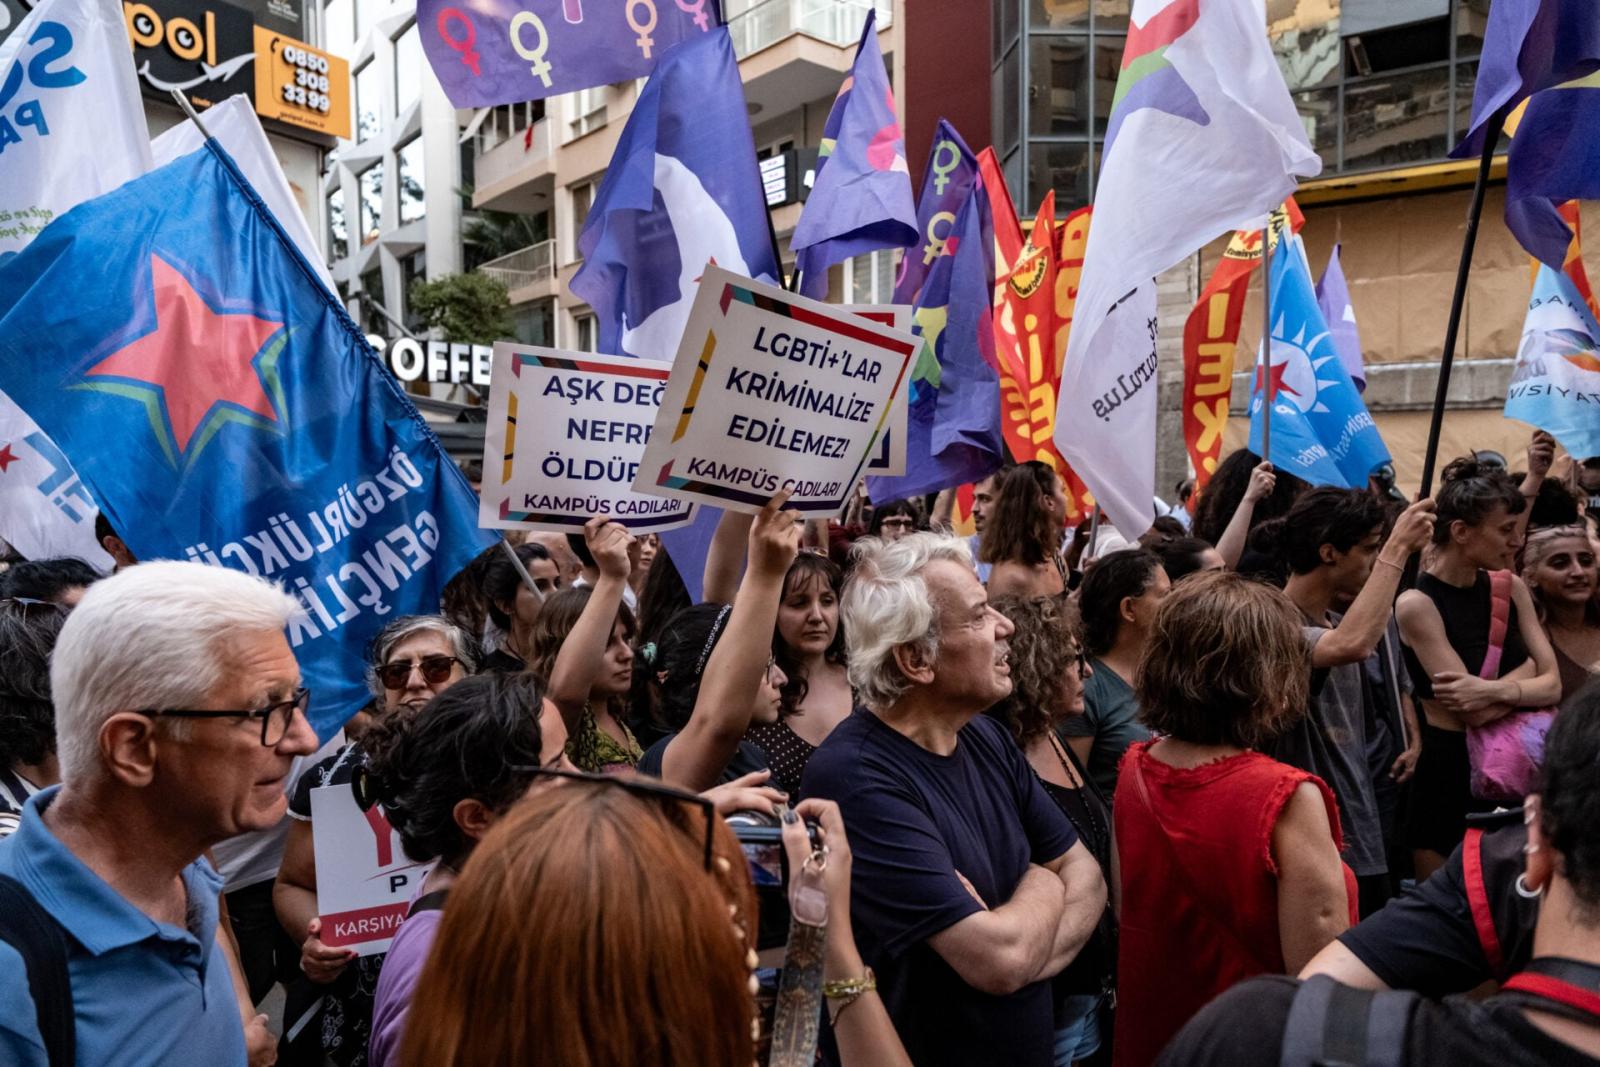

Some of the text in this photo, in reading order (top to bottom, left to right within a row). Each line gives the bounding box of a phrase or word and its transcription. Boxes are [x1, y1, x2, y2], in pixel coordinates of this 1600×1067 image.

[283, 45, 328, 74] 0850
[295, 68, 329, 94] 308
[752, 326, 882, 383] LGBTİ+'LAR
[542, 375, 605, 405] AŞK
[725, 366, 874, 423] KRİMİNALİZE
[726, 413, 850, 459] EDİLEMEZ!
[687, 457, 779, 492] KAMPÜS
[524, 493, 681, 515] KAMPÜS CADILARI
[335, 913, 405, 937] KARŞIYA
